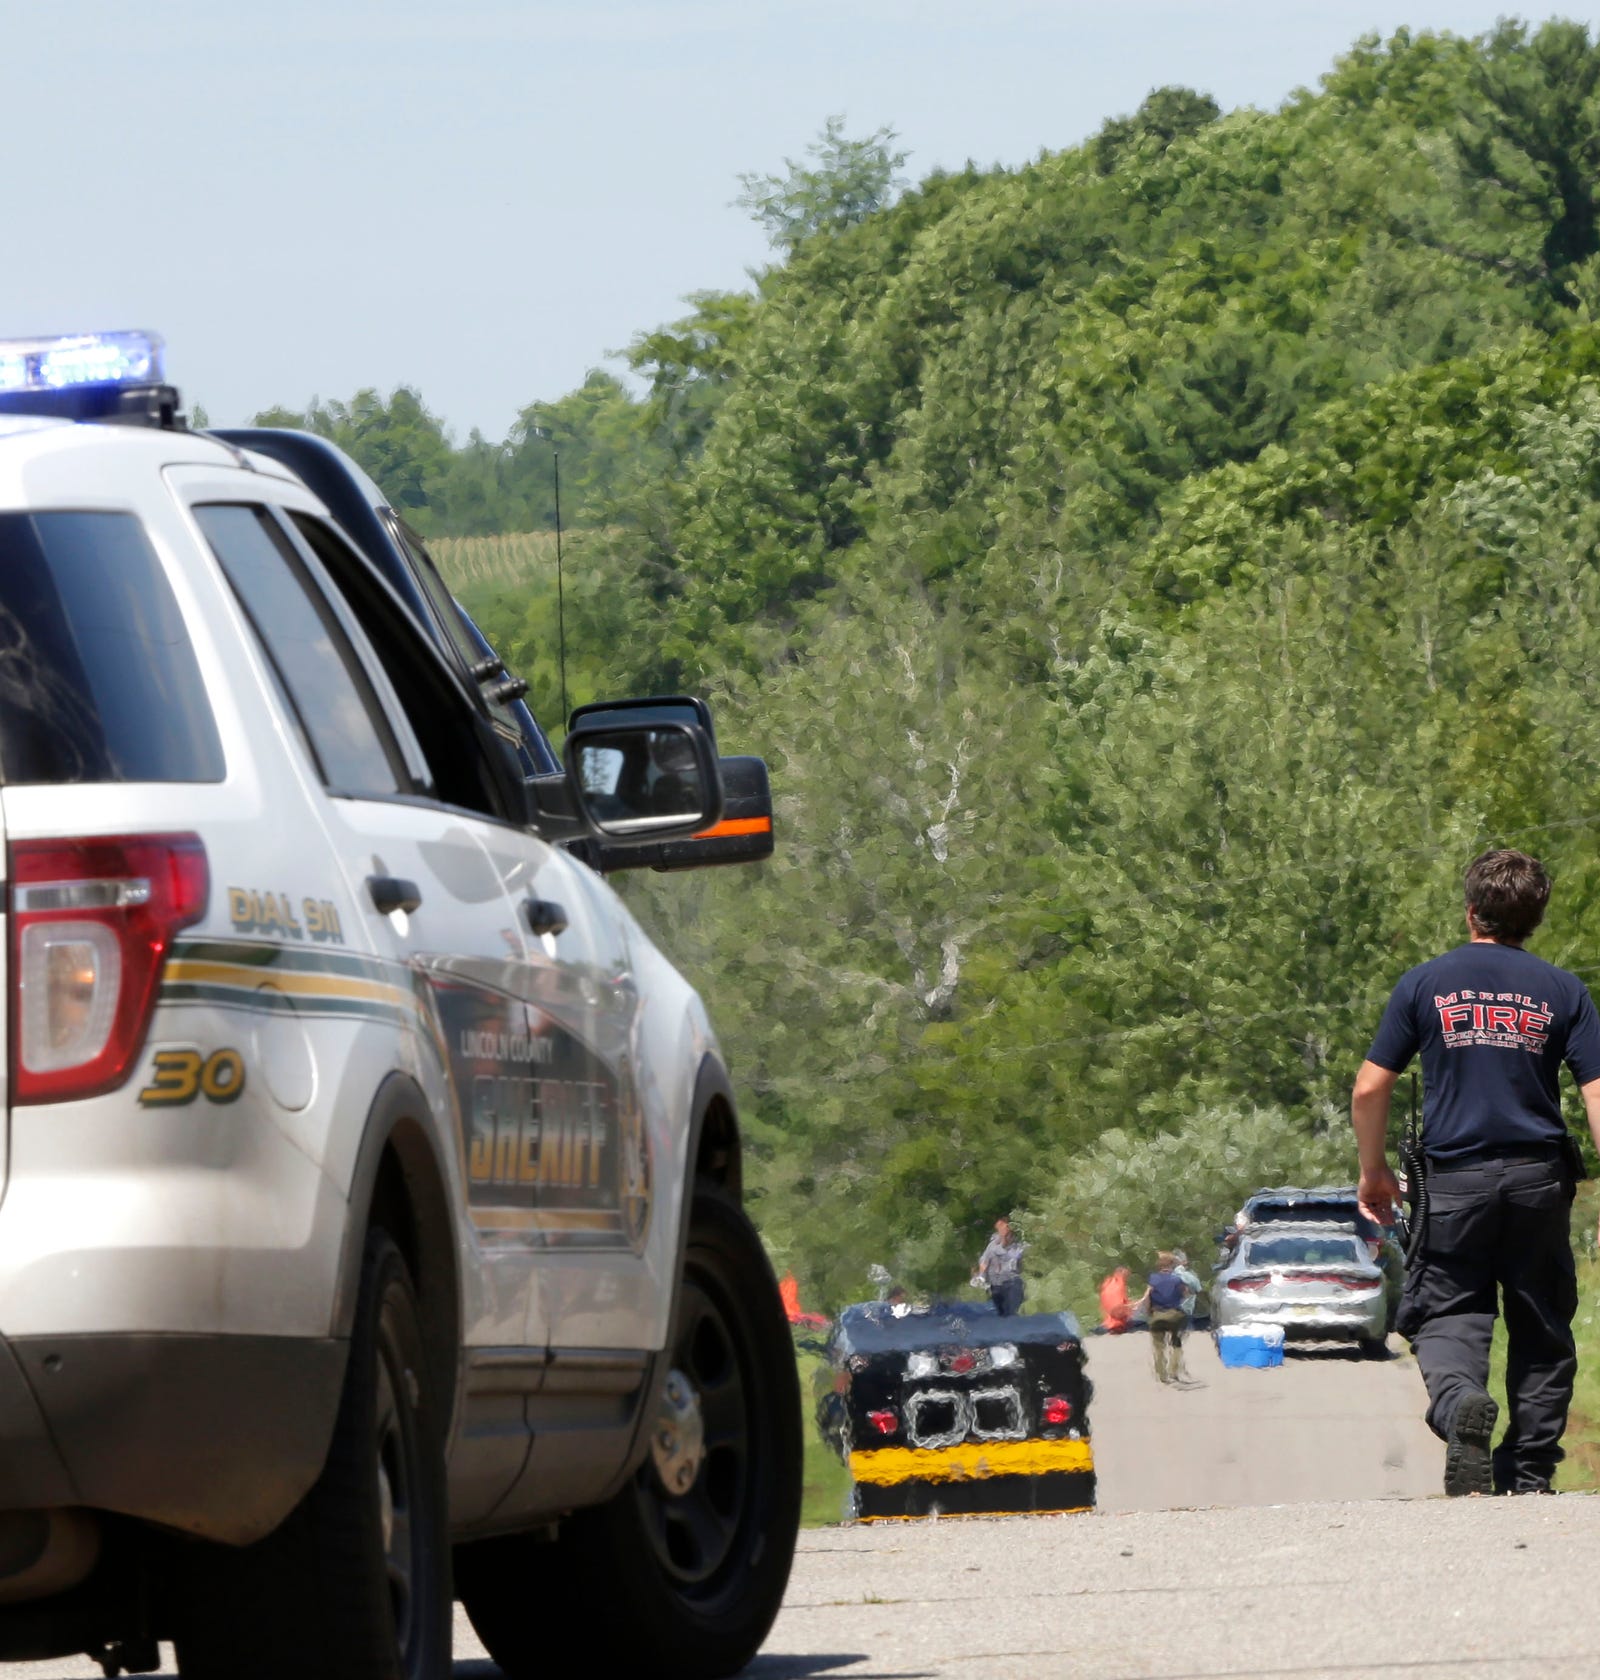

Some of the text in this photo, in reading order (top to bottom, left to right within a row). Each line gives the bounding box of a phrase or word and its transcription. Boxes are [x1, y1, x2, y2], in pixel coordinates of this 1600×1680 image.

[228, 886, 343, 942] DIAL 911
[1434, 990, 1554, 1017] MERRILL
[1438, 1003, 1552, 1041] FIRE
[461, 1030, 553, 1064] LINCOLN COUNTY
[138, 1048, 245, 1108] 30
[469, 1075, 607, 1188] SHERIFF
